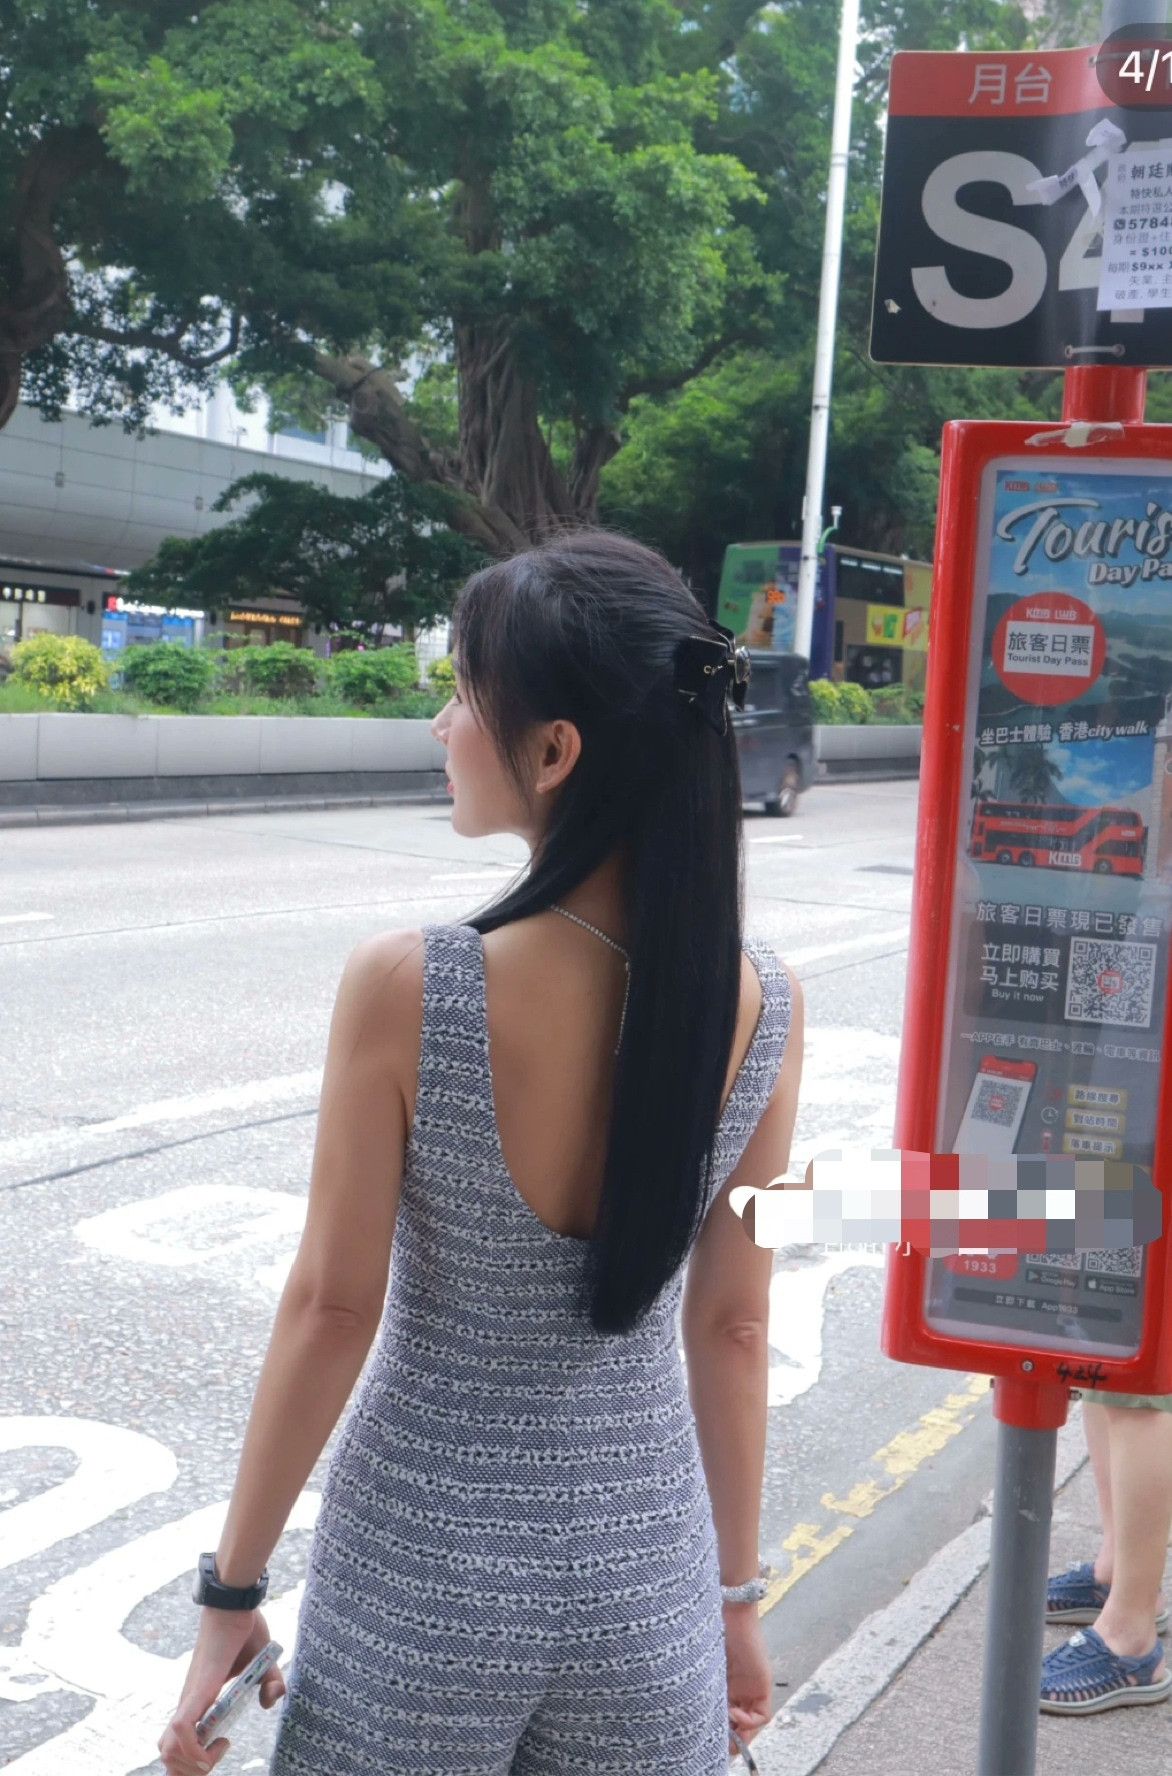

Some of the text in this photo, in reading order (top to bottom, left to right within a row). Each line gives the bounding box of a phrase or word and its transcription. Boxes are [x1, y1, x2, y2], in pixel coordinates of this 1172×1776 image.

[968, 62, 1053, 105] 月台
[1129, 216, 1172, 230] 5784
[1089, 561, 1139, 587] Day
[1008, 632, 1090, 655] 旅客日票
[1008, 653, 1088, 668] Tourist Day Pass
[1115, 720, 1148, 736] walk
[976, 902, 1163, 937] 旅客日票現已發售
[981, 942, 1060, 968] 立即購買
[980, 965, 1060, 991] 马上购买
[991, 988, 1044, 1003] Buy it now
[963, 1260, 997, 1274] 1933
